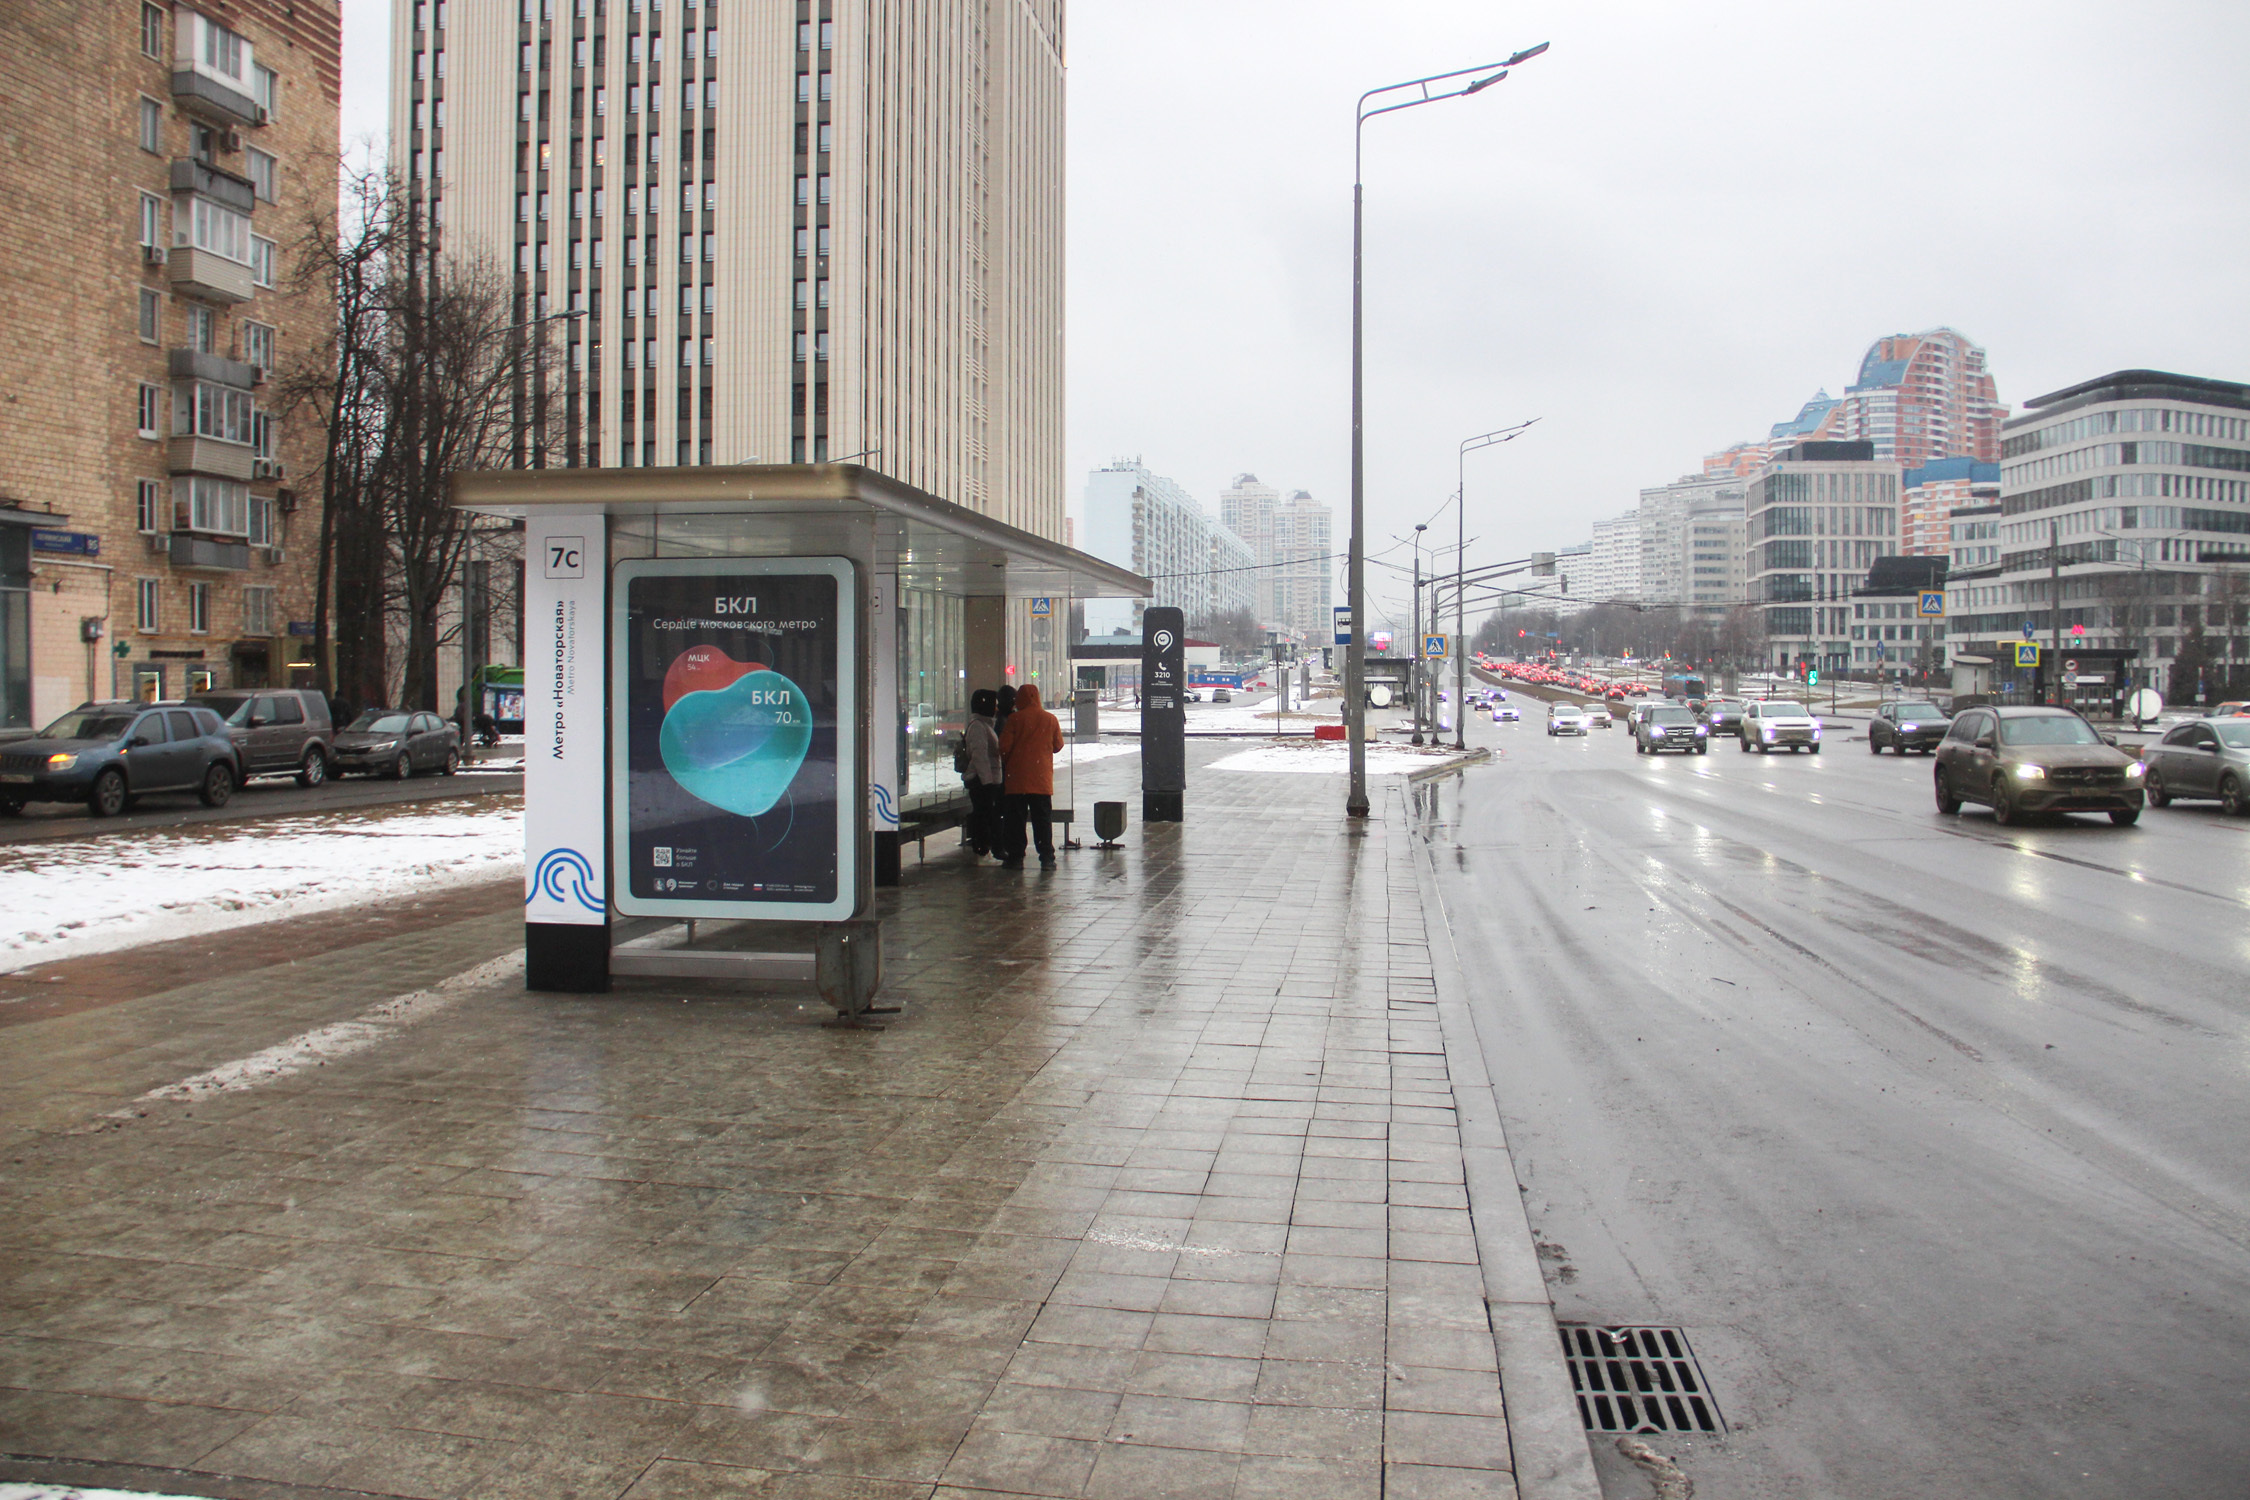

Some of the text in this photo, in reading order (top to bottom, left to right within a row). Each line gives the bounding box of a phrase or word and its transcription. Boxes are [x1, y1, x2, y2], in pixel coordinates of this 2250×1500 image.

[715, 597, 757, 614] БКЛ
[653, 619, 697, 631] Сердце
[700, 620, 776, 630] московского
[779, 620, 817, 631] метро
[567, 600, 576, 695] Metro Novatorskaya
[688, 654, 710, 663] МЦК
[687, 663, 696, 671] 54
[553, 600, 566, 760] Метро «Новаторская»
[1154, 671, 1171, 679] 3210
[752, 690, 790, 705] БКЛ
[775, 711, 792, 724] 70
